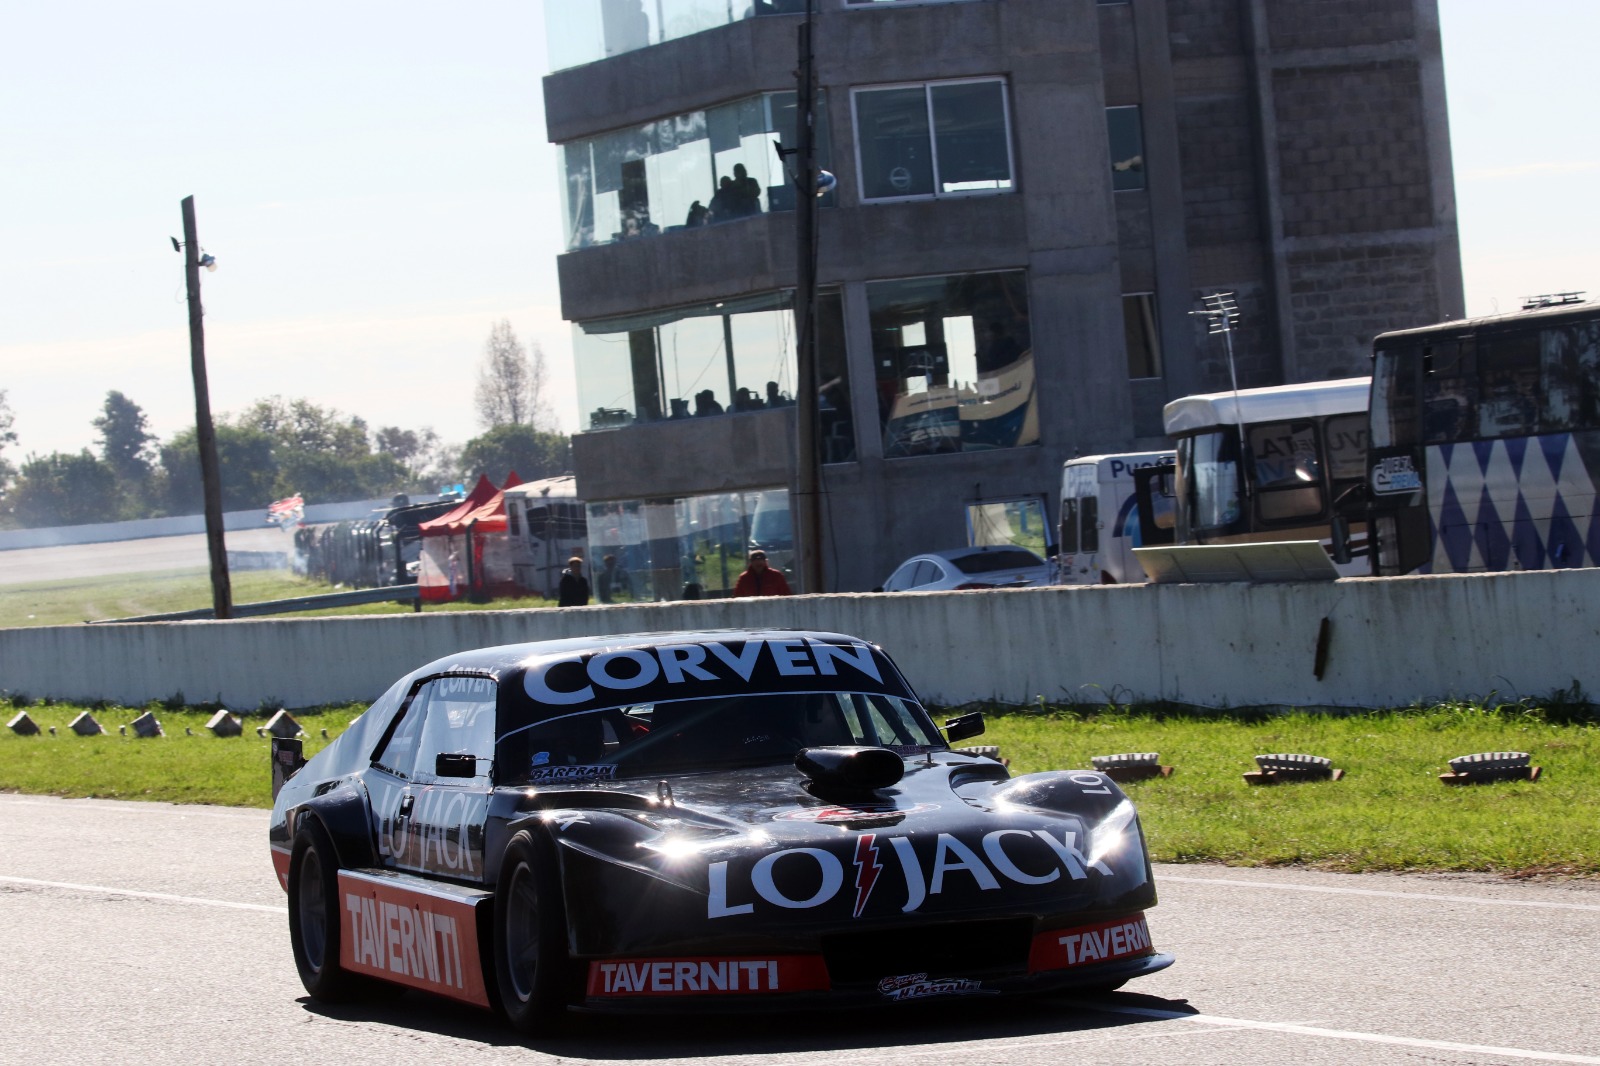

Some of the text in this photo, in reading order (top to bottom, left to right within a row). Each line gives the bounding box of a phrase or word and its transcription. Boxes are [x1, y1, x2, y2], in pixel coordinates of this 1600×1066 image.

[524, 638, 884, 705] CORVEN
[707, 829, 1115, 919] LO JACK
[346, 893, 463, 989] TAVERNITI
[600, 960, 779, 993] TAVERNITI
